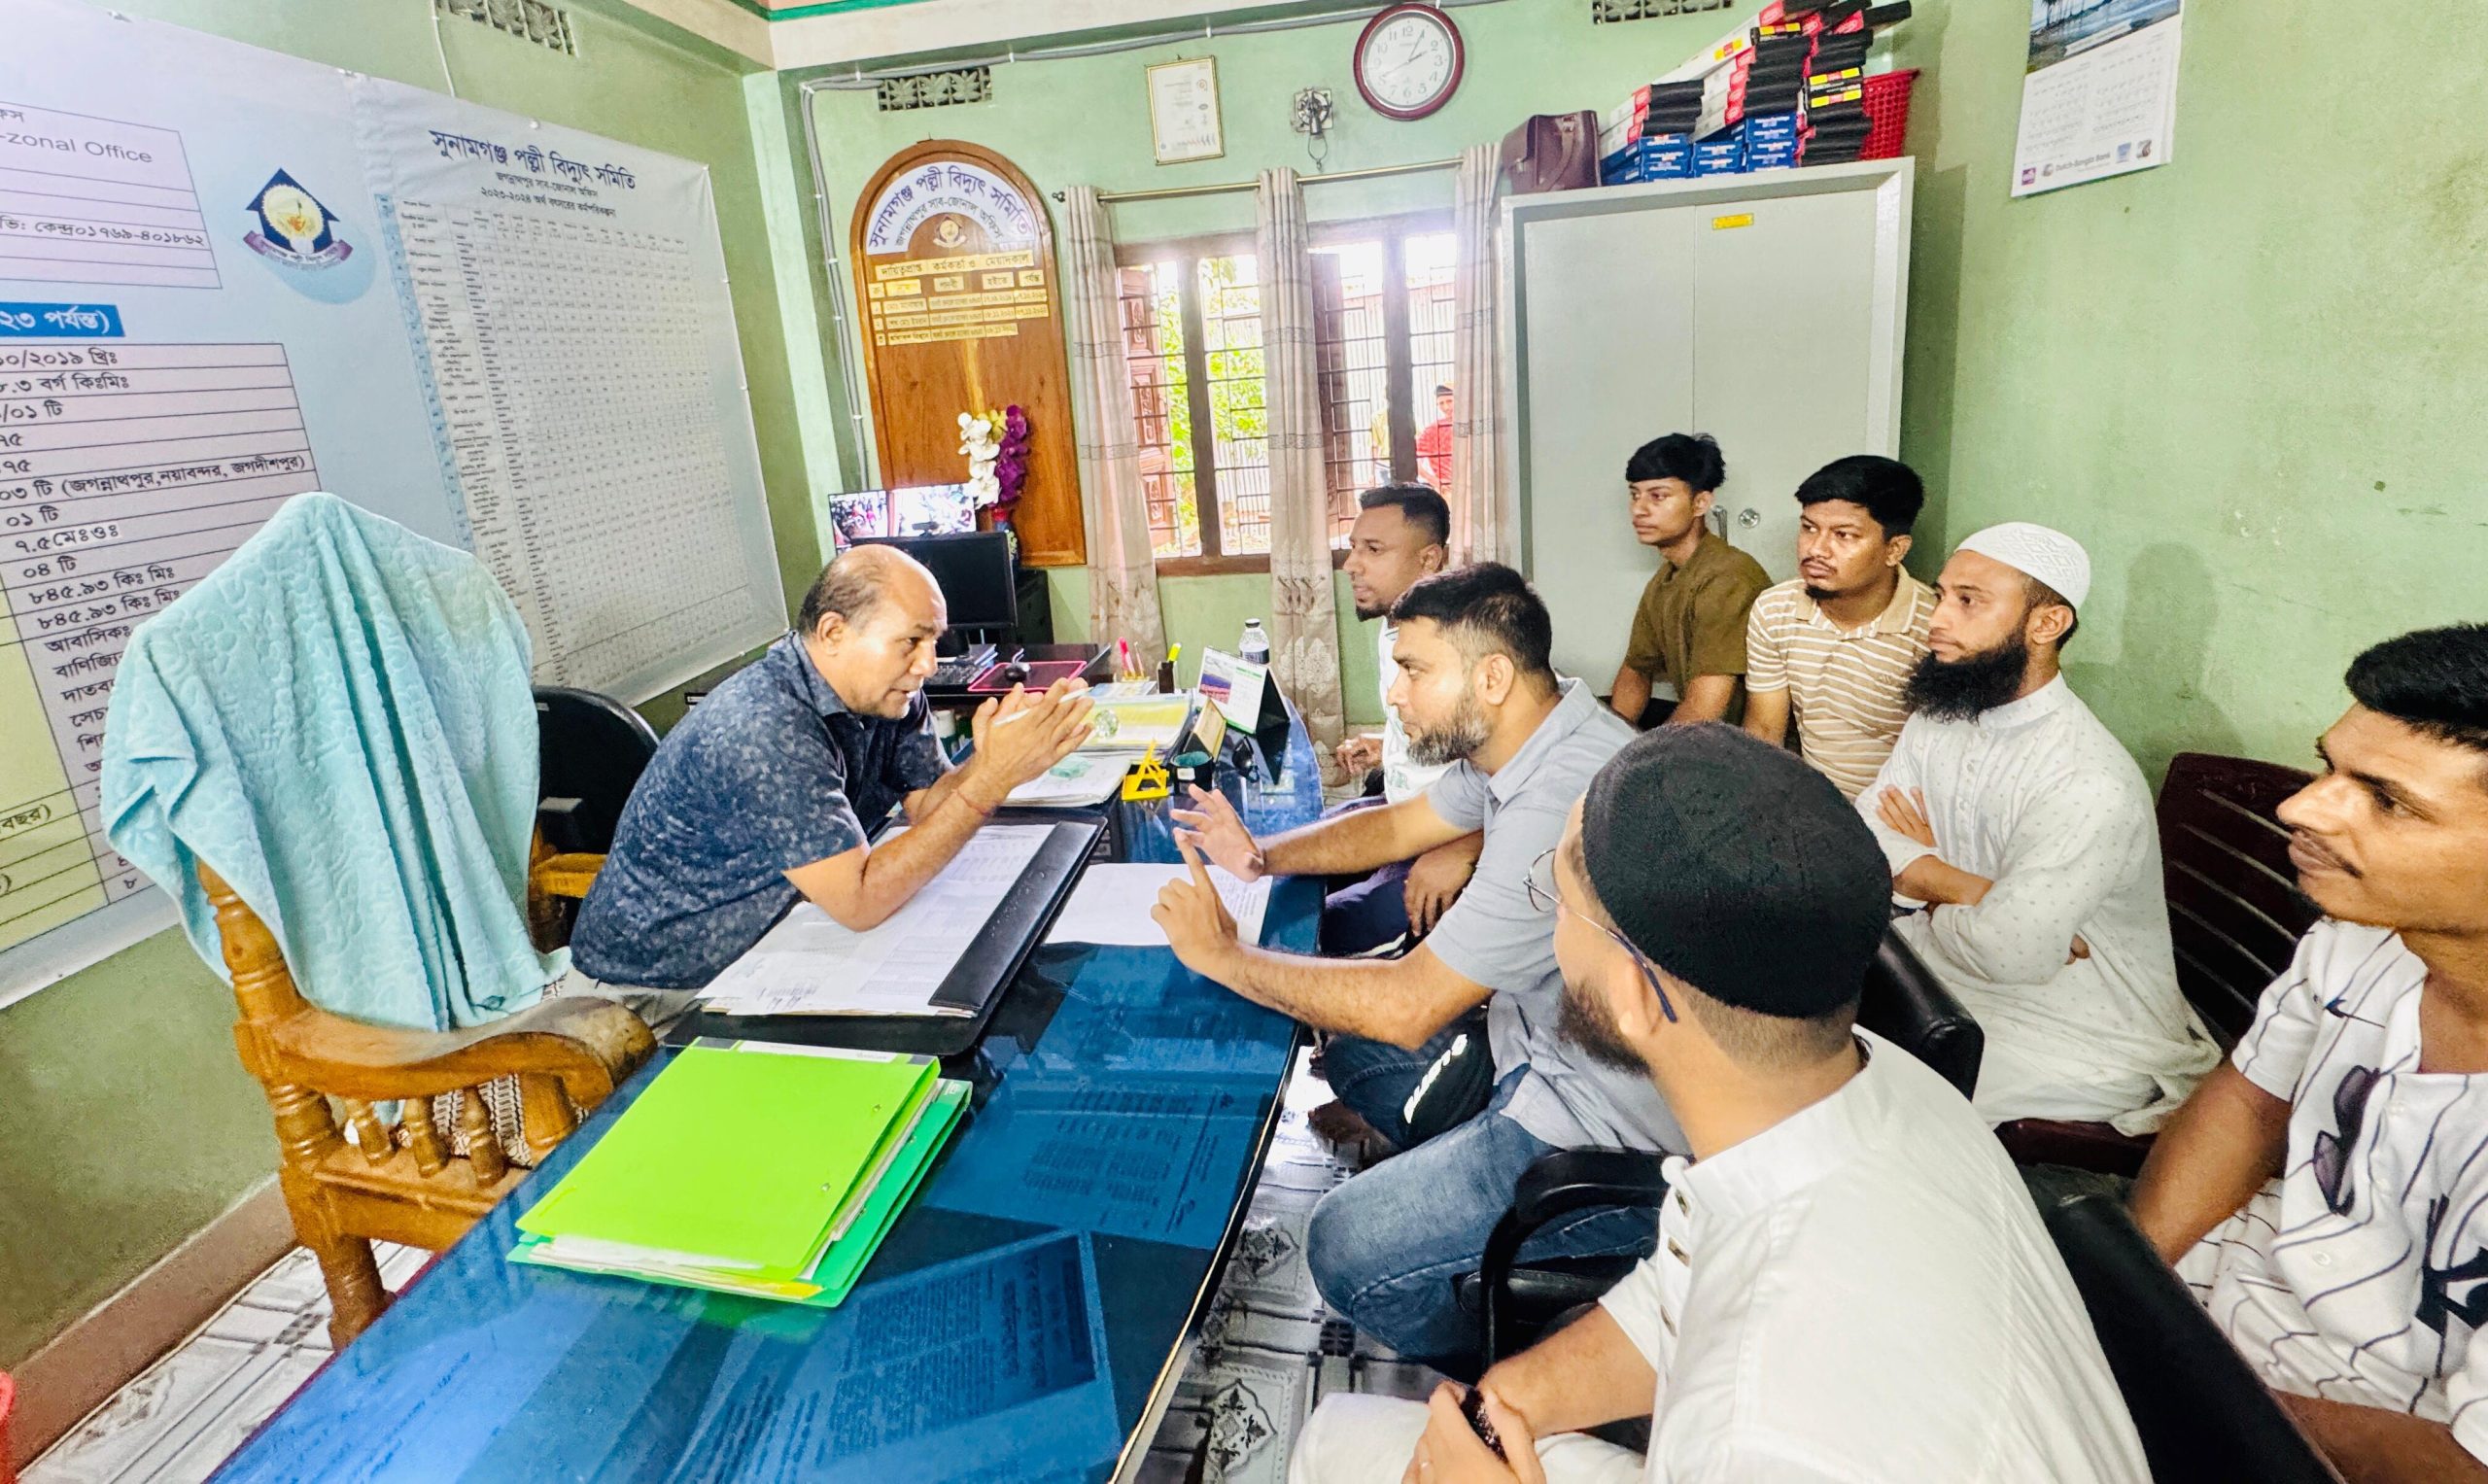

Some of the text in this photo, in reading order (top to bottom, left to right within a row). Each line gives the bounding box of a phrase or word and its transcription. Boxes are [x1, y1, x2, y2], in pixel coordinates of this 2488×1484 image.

[86, 141, 153, 163] Office
[429, 130, 637, 190] সুনামগঞ্জ পল্লী বিদ্যুৎ সমিতি
[869, 165, 1033, 248] সুনামগঞ্জ পল্লী বিদ্যুৎ সমিতি
[44, 305, 110, 334] পর্যন্ত)
[36, 372, 67, 391] বর্গ
[0, 399, 64, 423] /০১ টি
[32, 479, 53, 498] টি
[231, 455, 305, 475] জগদীশপুর)
[6, 505, 59, 527] ০১ টি
[23, 555, 77, 578] ০৪ টি
[29, 565, 176, 604] ৮৪৫.৯৩ কিঃ মিঃ
[38, 604, 117, 630] ৮৪৫.৯৩
[121, 595, 151, 612] কিঃ
[44, 625, 131, 653] আবাসিকঃ
[52, 651, 124, 679] বাণিজ্যি
[60, 678, 115, 705] দাতব
